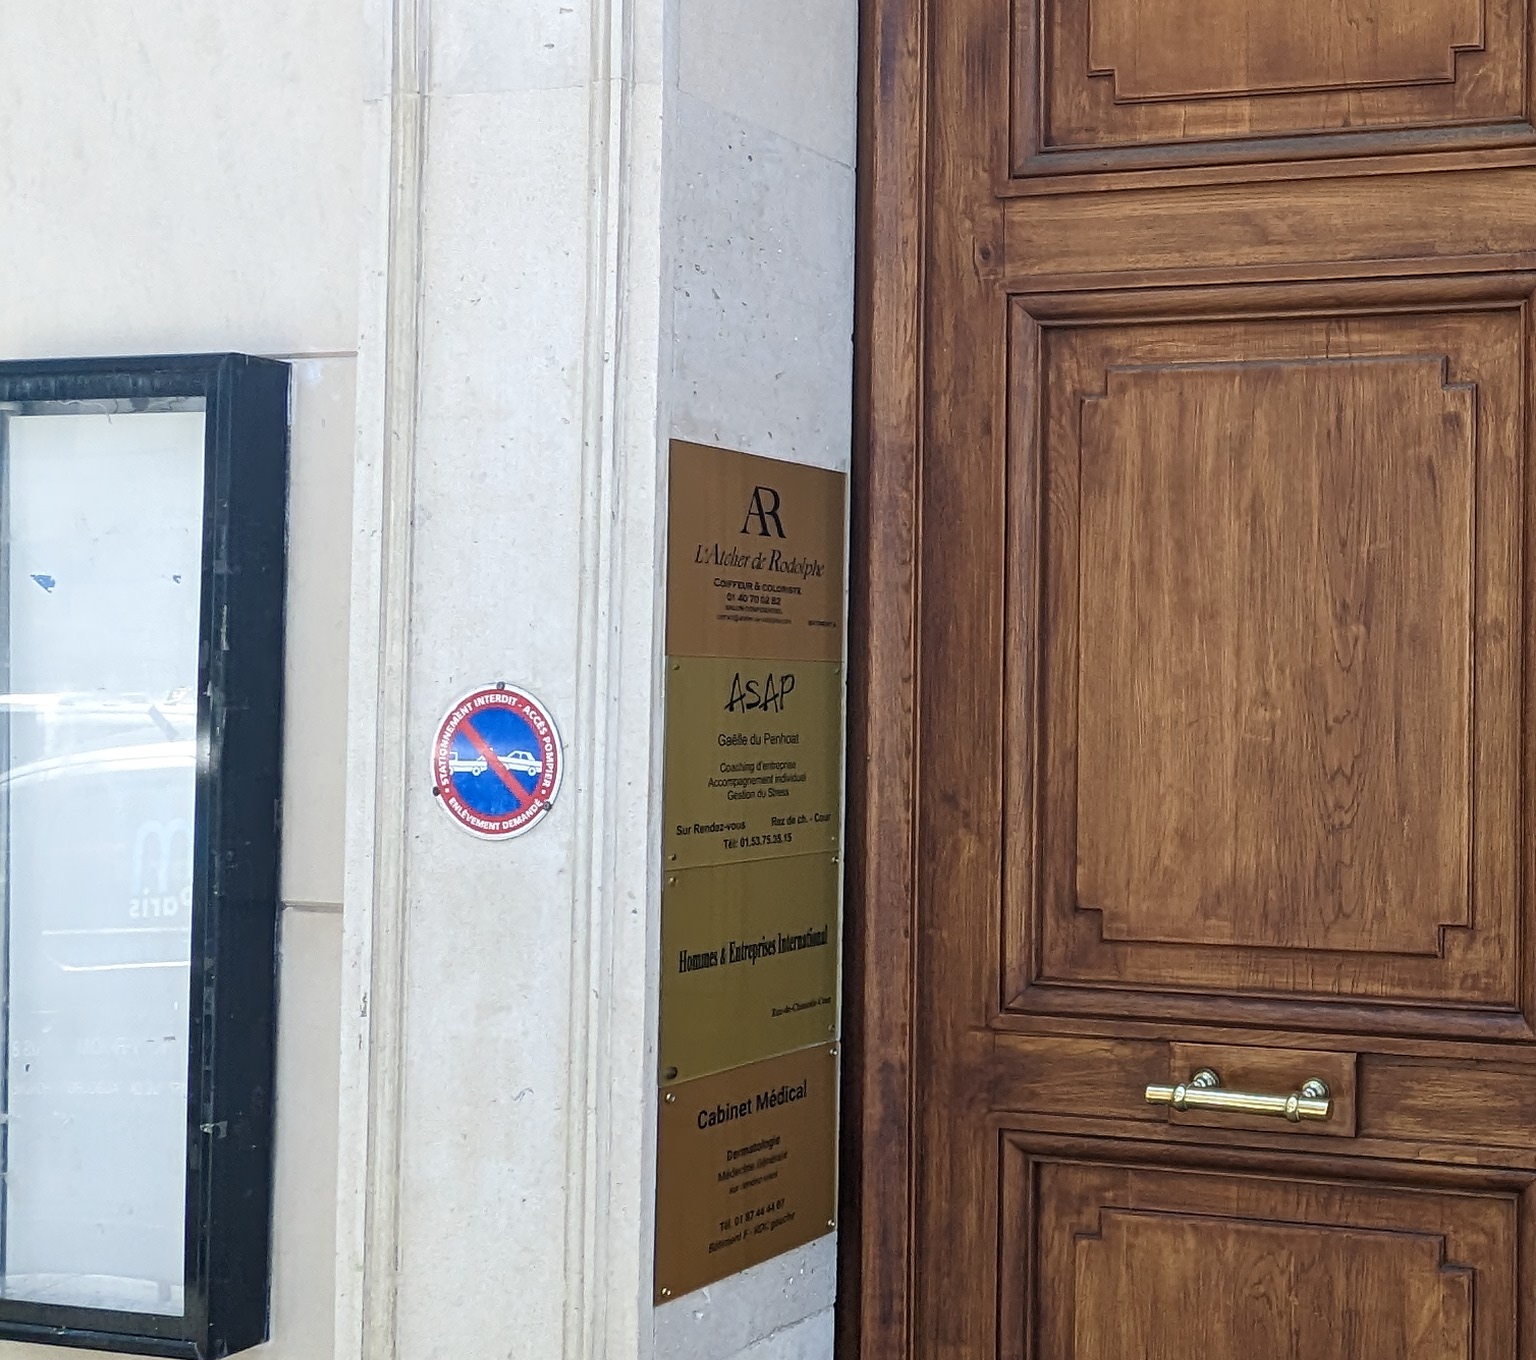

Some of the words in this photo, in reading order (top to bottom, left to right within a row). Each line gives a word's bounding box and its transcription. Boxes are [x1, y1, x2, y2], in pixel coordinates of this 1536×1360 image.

[740, 485, 787, 539] AR
[694, 543, 750, 569] L'Atelier
[751, 552, 767, 570] de
[768, 548, 825, 580] Rodolphe
[725, 673, 795, 713] ASAP
[438, 704, 473, 786] STATIONNEMENT
[474, 693, 518, 708] INTERDIT
[542, 736, 556, 791] POMPIER
[750, 734, 762, 745] du
[764, 733, 799, 745] Penhoat
[720, 762, 755, 774] Coaching
[727, 790, 755, 800] Gestion
[757, 789, 767, 798] du
[676, 825, 691, 835] Sur
[693, 821, 746, 834] Rendez-vous
[771, 816, 786, 826] Rez
[787, 815, 797, 825] de
[679, 949, 718, 974] Hommes
[720, 951, 726, 965] &
[729, 936, 776, 965] Entreprises
[778, 925, 829, 953] International
[697, 1099, 753, 1130] Cabinet
[755, 1079, 808, 1112] Médical
[726, 1135, 781, 1162] Dermatologie
